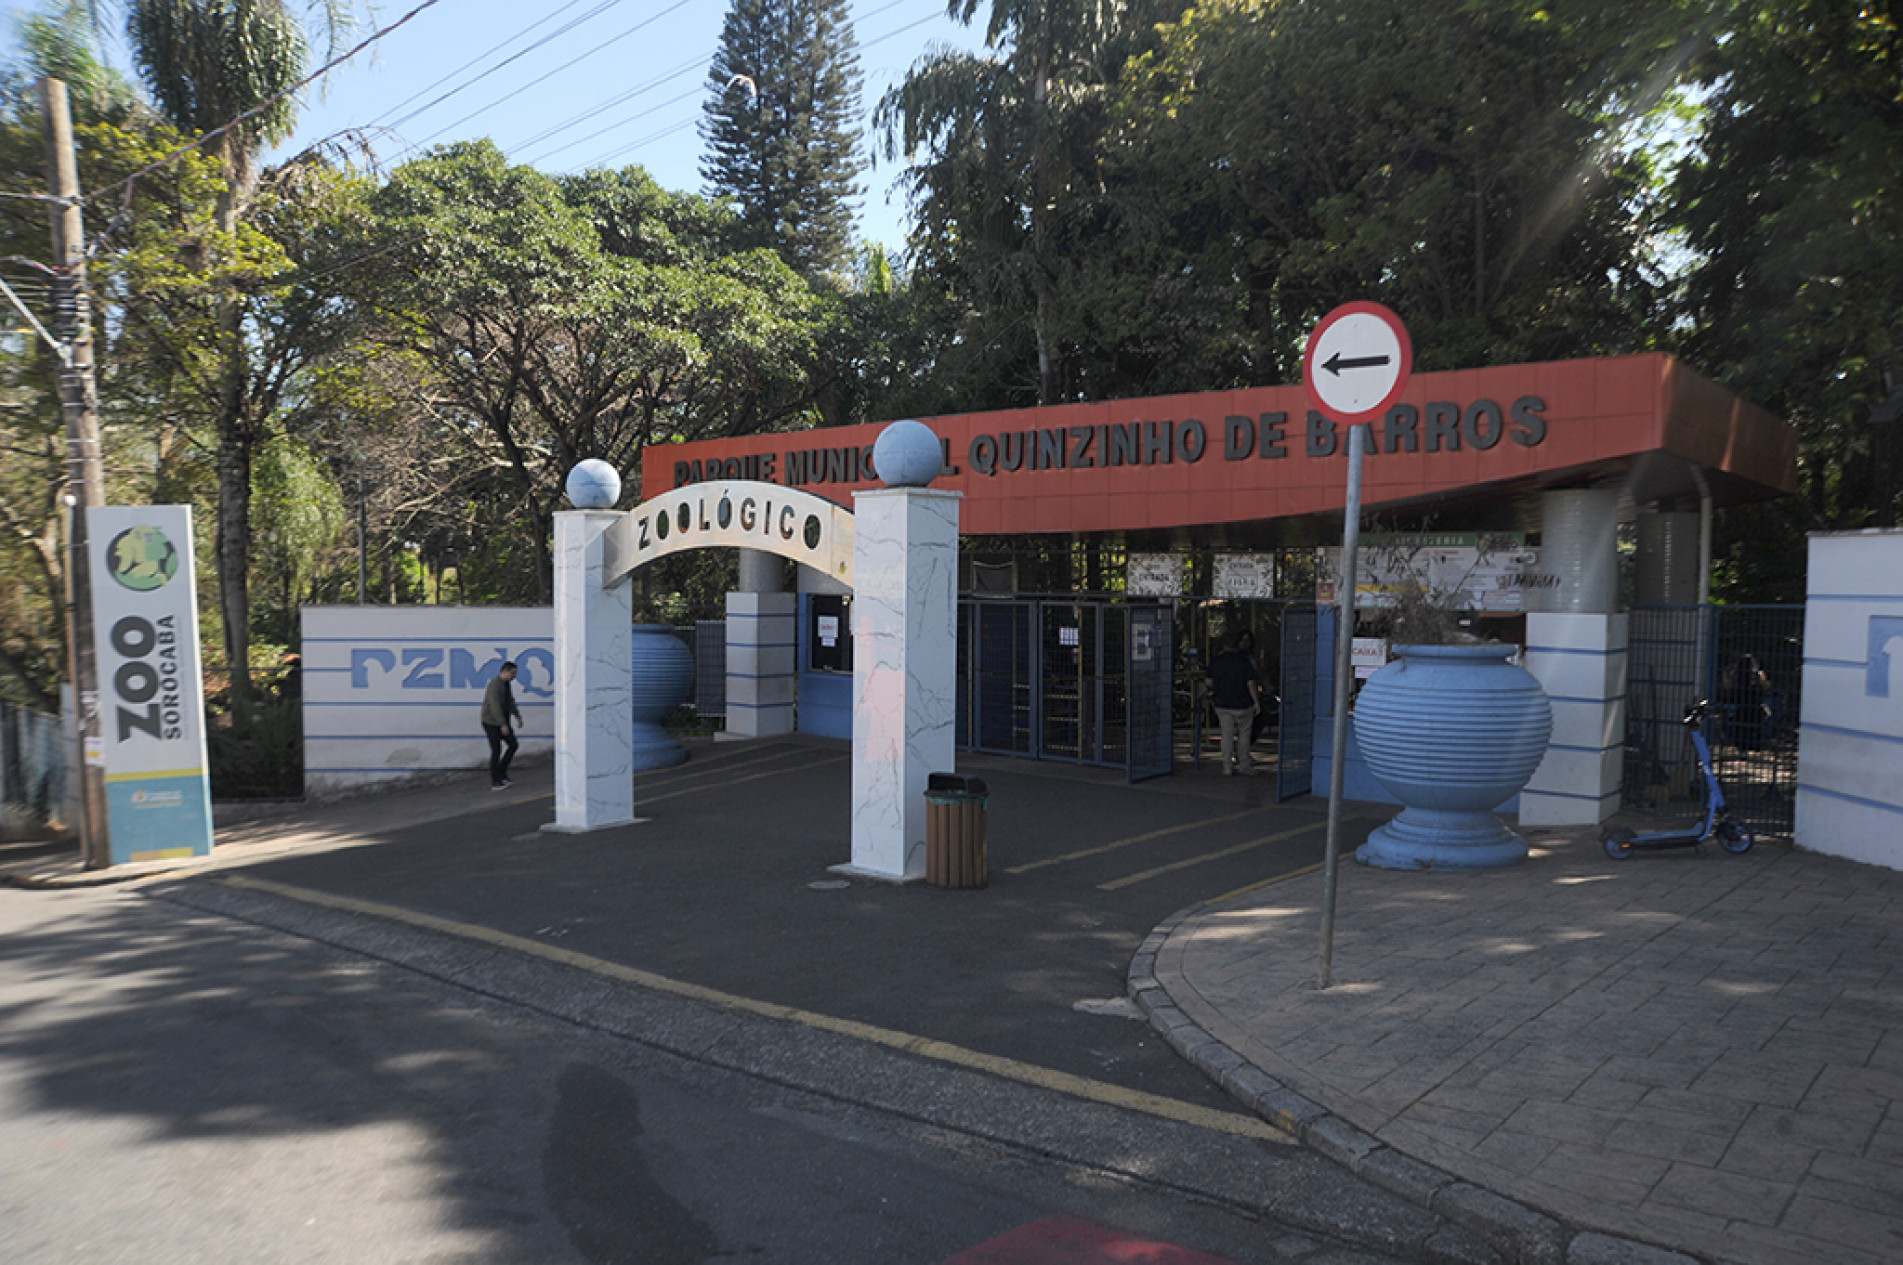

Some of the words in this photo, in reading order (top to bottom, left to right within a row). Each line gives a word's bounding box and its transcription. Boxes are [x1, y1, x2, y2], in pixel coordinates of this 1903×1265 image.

[673, 452, 776, 488] PARQUE
[784, 437, 959, 486] MUNICL
[968, 418, 1207, 476] QUINZINHO
[1224, 411, 1288, 461] DE
[638, 487, 821, 551] ZOOLÓGICO
[110, 614, 163, 744] ZOO
[155, 614, 182, 741] SOROCABA
